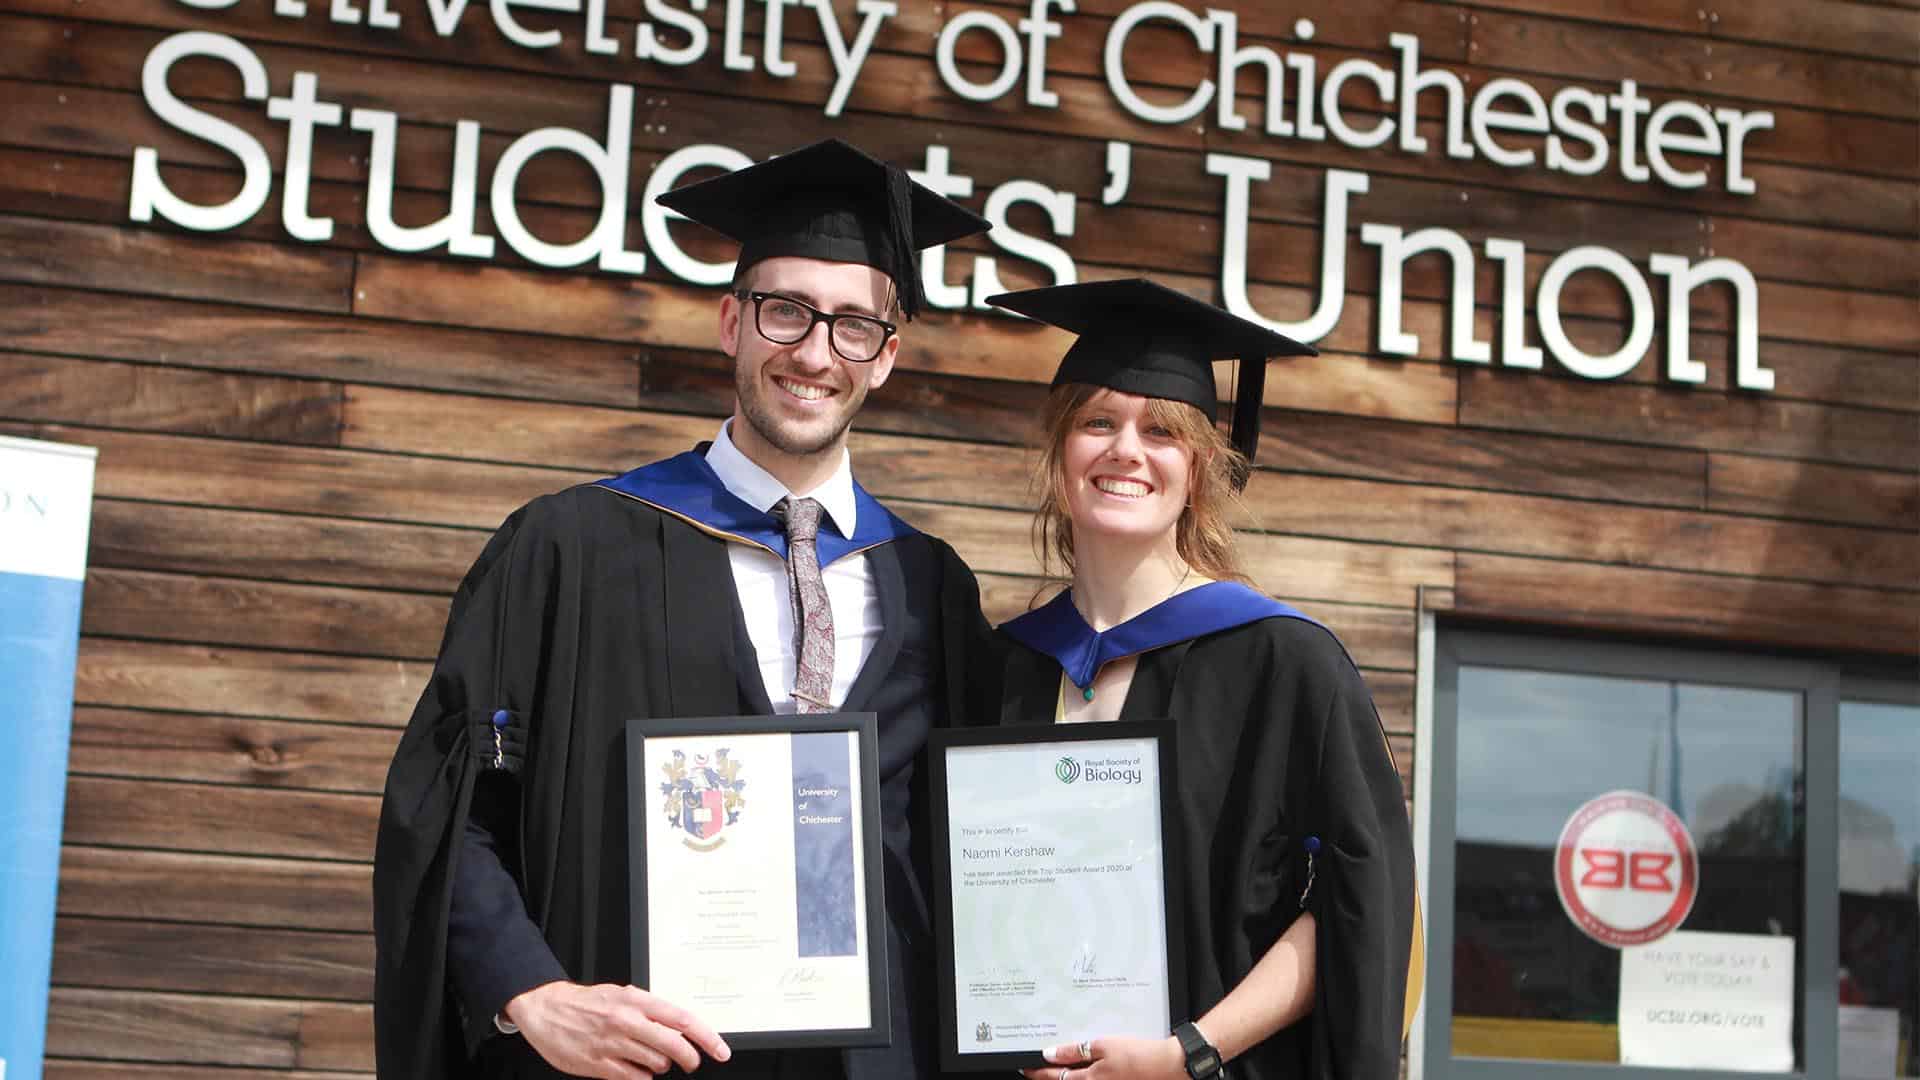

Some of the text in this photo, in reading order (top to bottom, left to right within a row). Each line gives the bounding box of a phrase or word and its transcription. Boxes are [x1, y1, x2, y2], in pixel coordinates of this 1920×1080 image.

[936, 0, 1076, 107] of
[1105, 1, 1774, 194] Chichester
[129, 31, 1774, 390] Studets' Union
[1085, 768, 1142, 784] Biology
[798, 788, 839, 798] University
[800, 816, 843, 824] Chichester
[962, 846, 1055, 860] Naomi Kershaw
[1643, 950, 1681, 964] HAVE
[1687, 952, 1725, 967] YOUR
[1730, 953, 1757, 968] SAY
